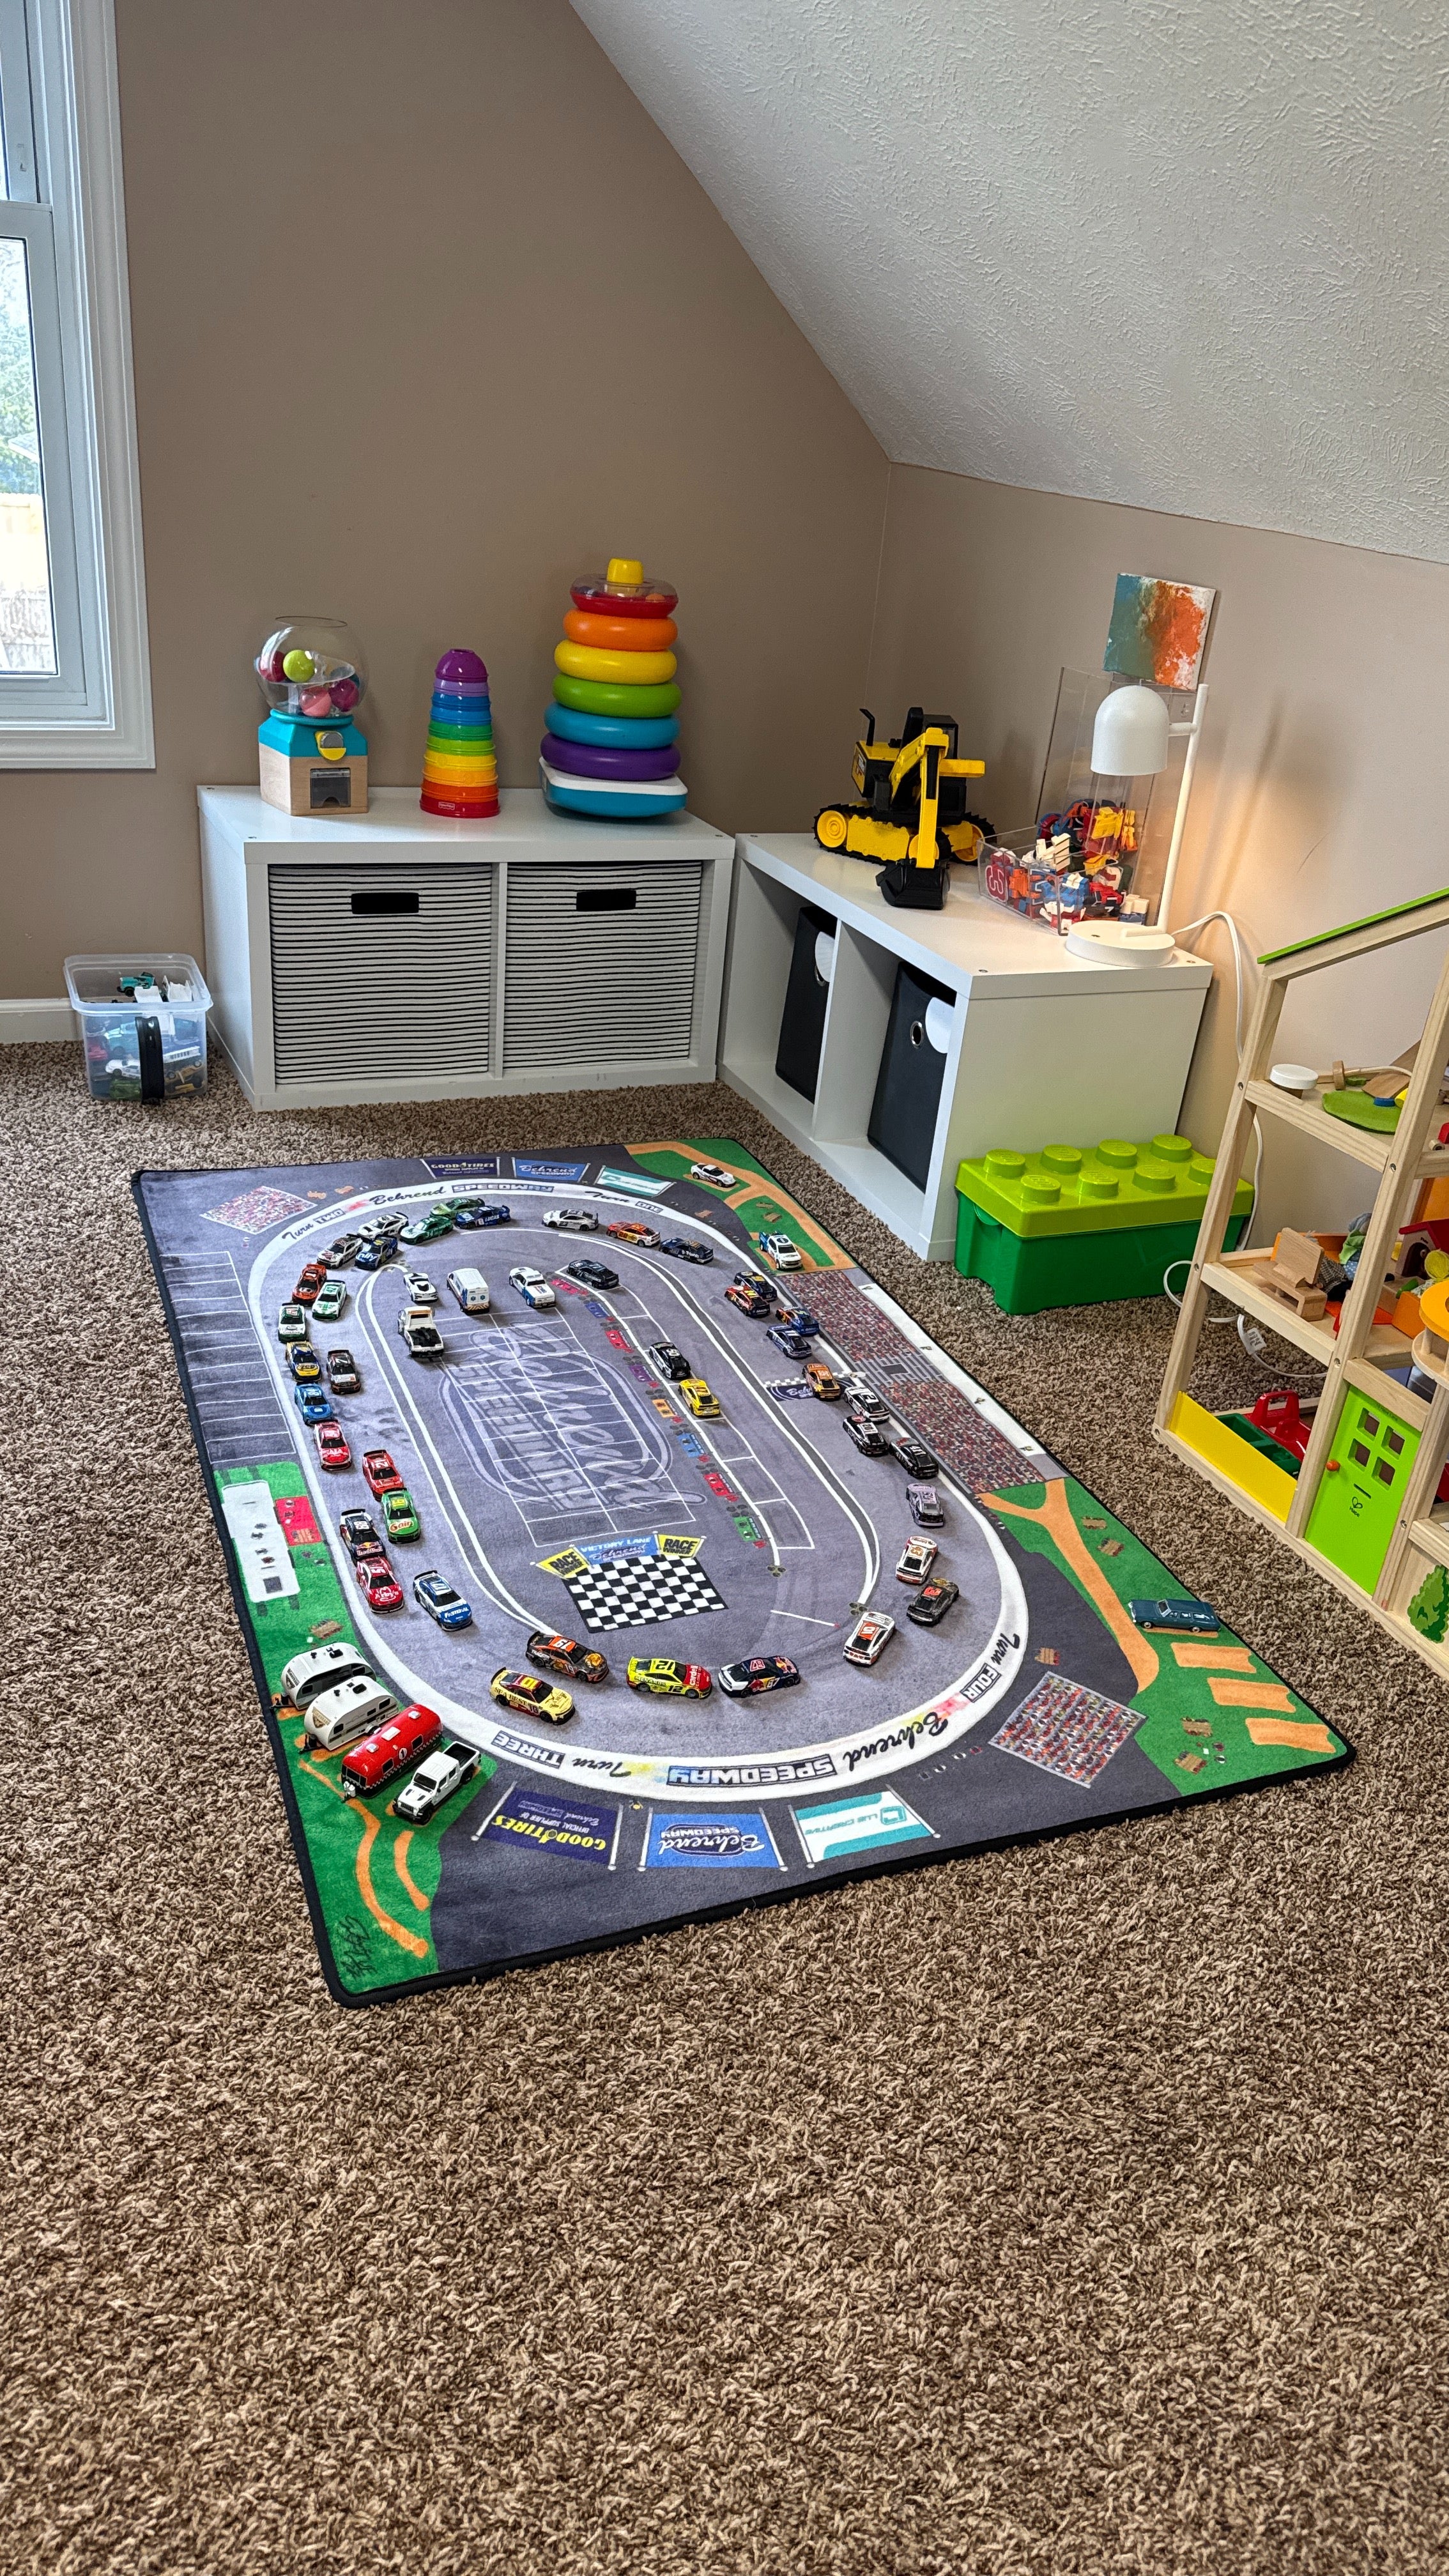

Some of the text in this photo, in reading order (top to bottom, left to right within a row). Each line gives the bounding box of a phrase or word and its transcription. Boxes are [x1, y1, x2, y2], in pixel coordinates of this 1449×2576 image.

[519, 1165, 578, 1174] Behrend
[585, 1190, 630, 1204] Turn
[282, 1184, 554, 1241] Turn TWO Behrend SPEEDWAY
[865, 1392, 877, 1402] 2
[390, 1520, 413, 1532] Gain
[581, 1540, 624, 1553] VICTORY
[663, 1538, 698, 1550] RACE
[548, 1551, 579, 1571] RACE
[374, 1591, 399, 1599] Arby's
[554, 1637, 571, 1649] 19
[565, 1664, 574, 1675] 19
[655, 1660, 675, 1670] 12
[962, 1632, 1020, 1700] Turn FOUR
[634, 1675, 666, 1687] MENARDS
[689, 1665, 699, 1687] cardell
[667, 1684, 684, 1693] 12
[766, 1678, 780, 1689] 87
[494, 1686, 528, 1706] SEA BEST
[528, 1703, 539, 1713] 10
[668, 1712, 949, 1784] Behrend SPEEDWAY
[493, 1732, 631, 1777] Turn THREE
[491, 1814, 606, 1850] GOOD TIRES
[661, 1826, 740, 1839] SPEEDWAY
[657, 1834, 765, 1855] Behrend
